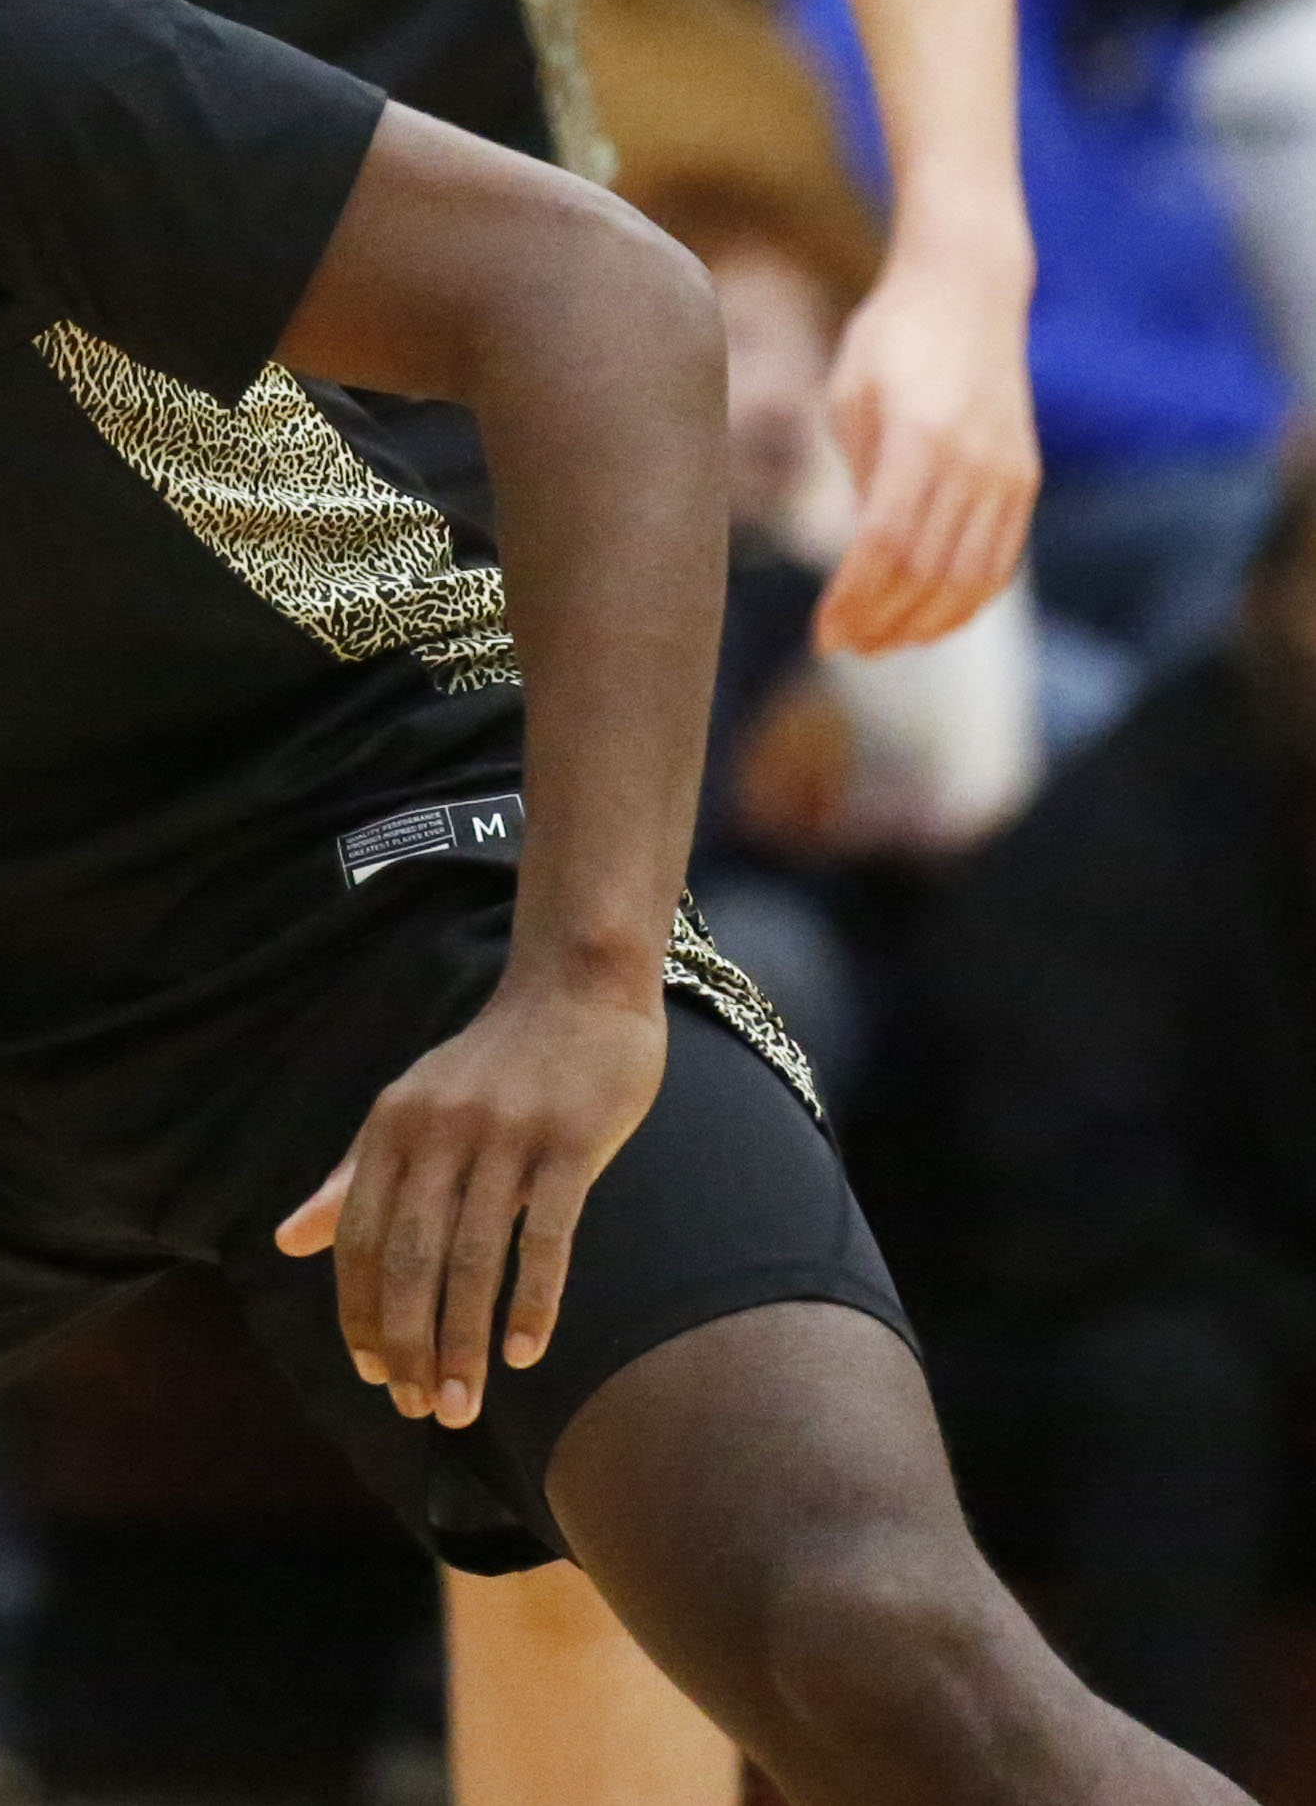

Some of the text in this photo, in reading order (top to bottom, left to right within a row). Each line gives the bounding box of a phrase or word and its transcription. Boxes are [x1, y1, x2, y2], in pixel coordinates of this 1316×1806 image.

[381, 811, 441, 831] PERFORMANCE
[471, 812, 507, 843] M
[424, 826, 445, 838] EVER
